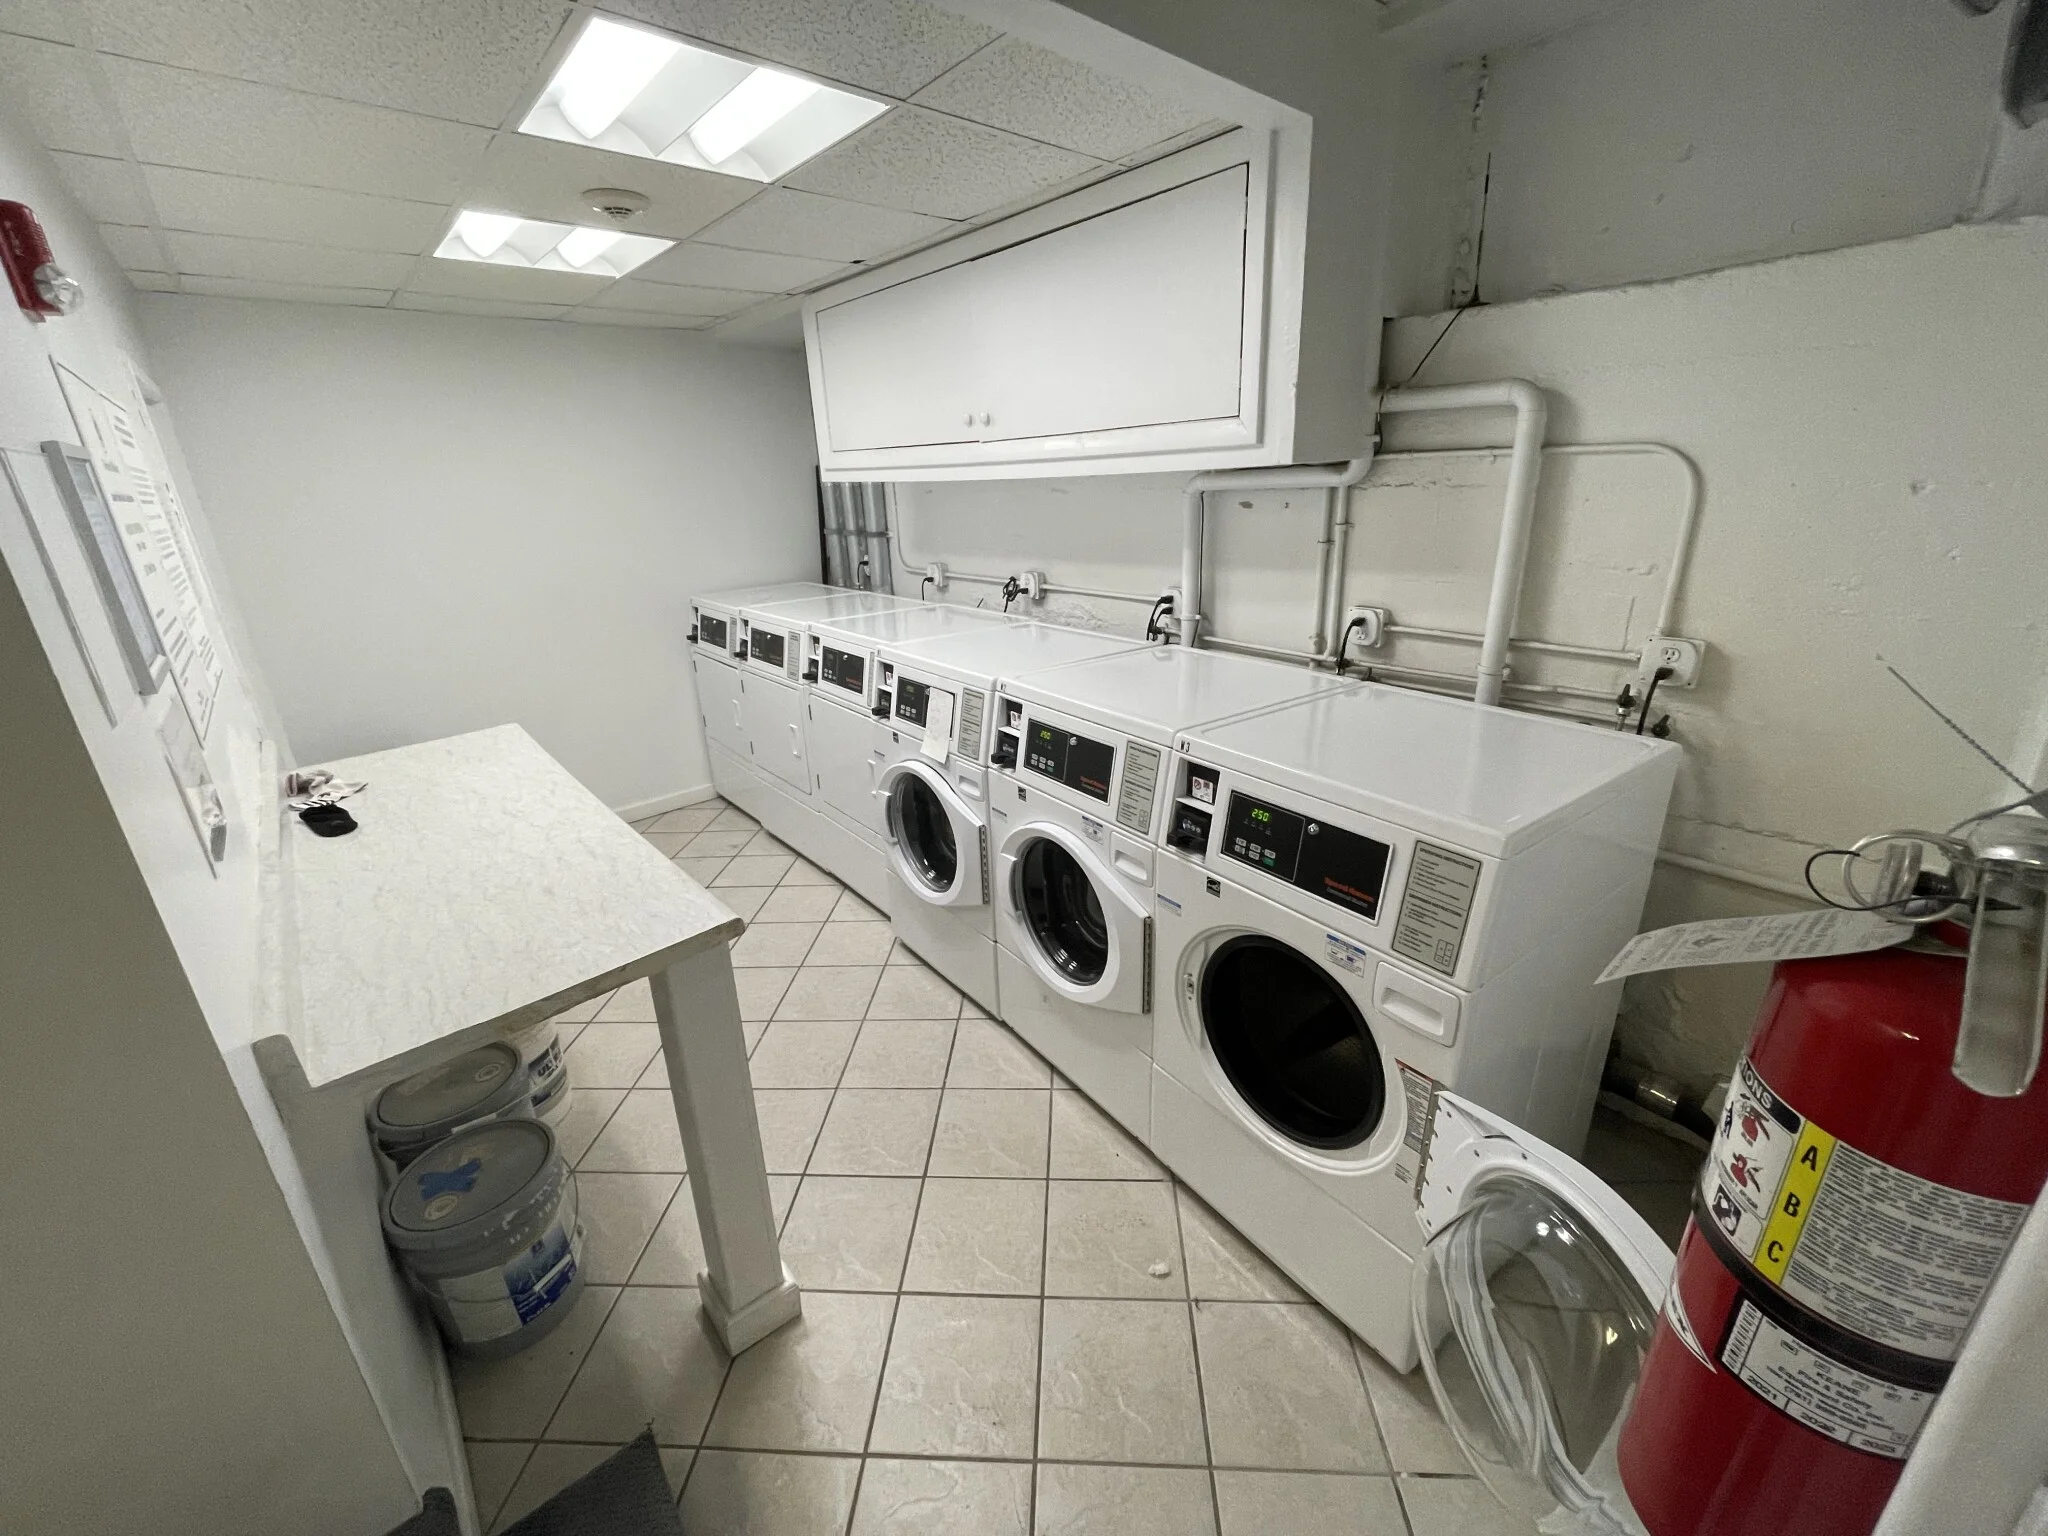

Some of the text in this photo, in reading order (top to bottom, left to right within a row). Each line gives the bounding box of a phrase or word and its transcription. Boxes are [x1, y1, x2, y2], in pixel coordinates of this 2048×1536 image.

[1251, 808, 1270, 822] 250
[1800, 1145, 1817, 1172] A
[1783, 1192, 1801, 1217] B
[1767, 1240, 1784, 1263] C
[1747, 1375, 1777, 1401] 2021
[1816, 1372, 1861, 1396] KEANE
[1800, 1412, 1836, 1434] 2022
